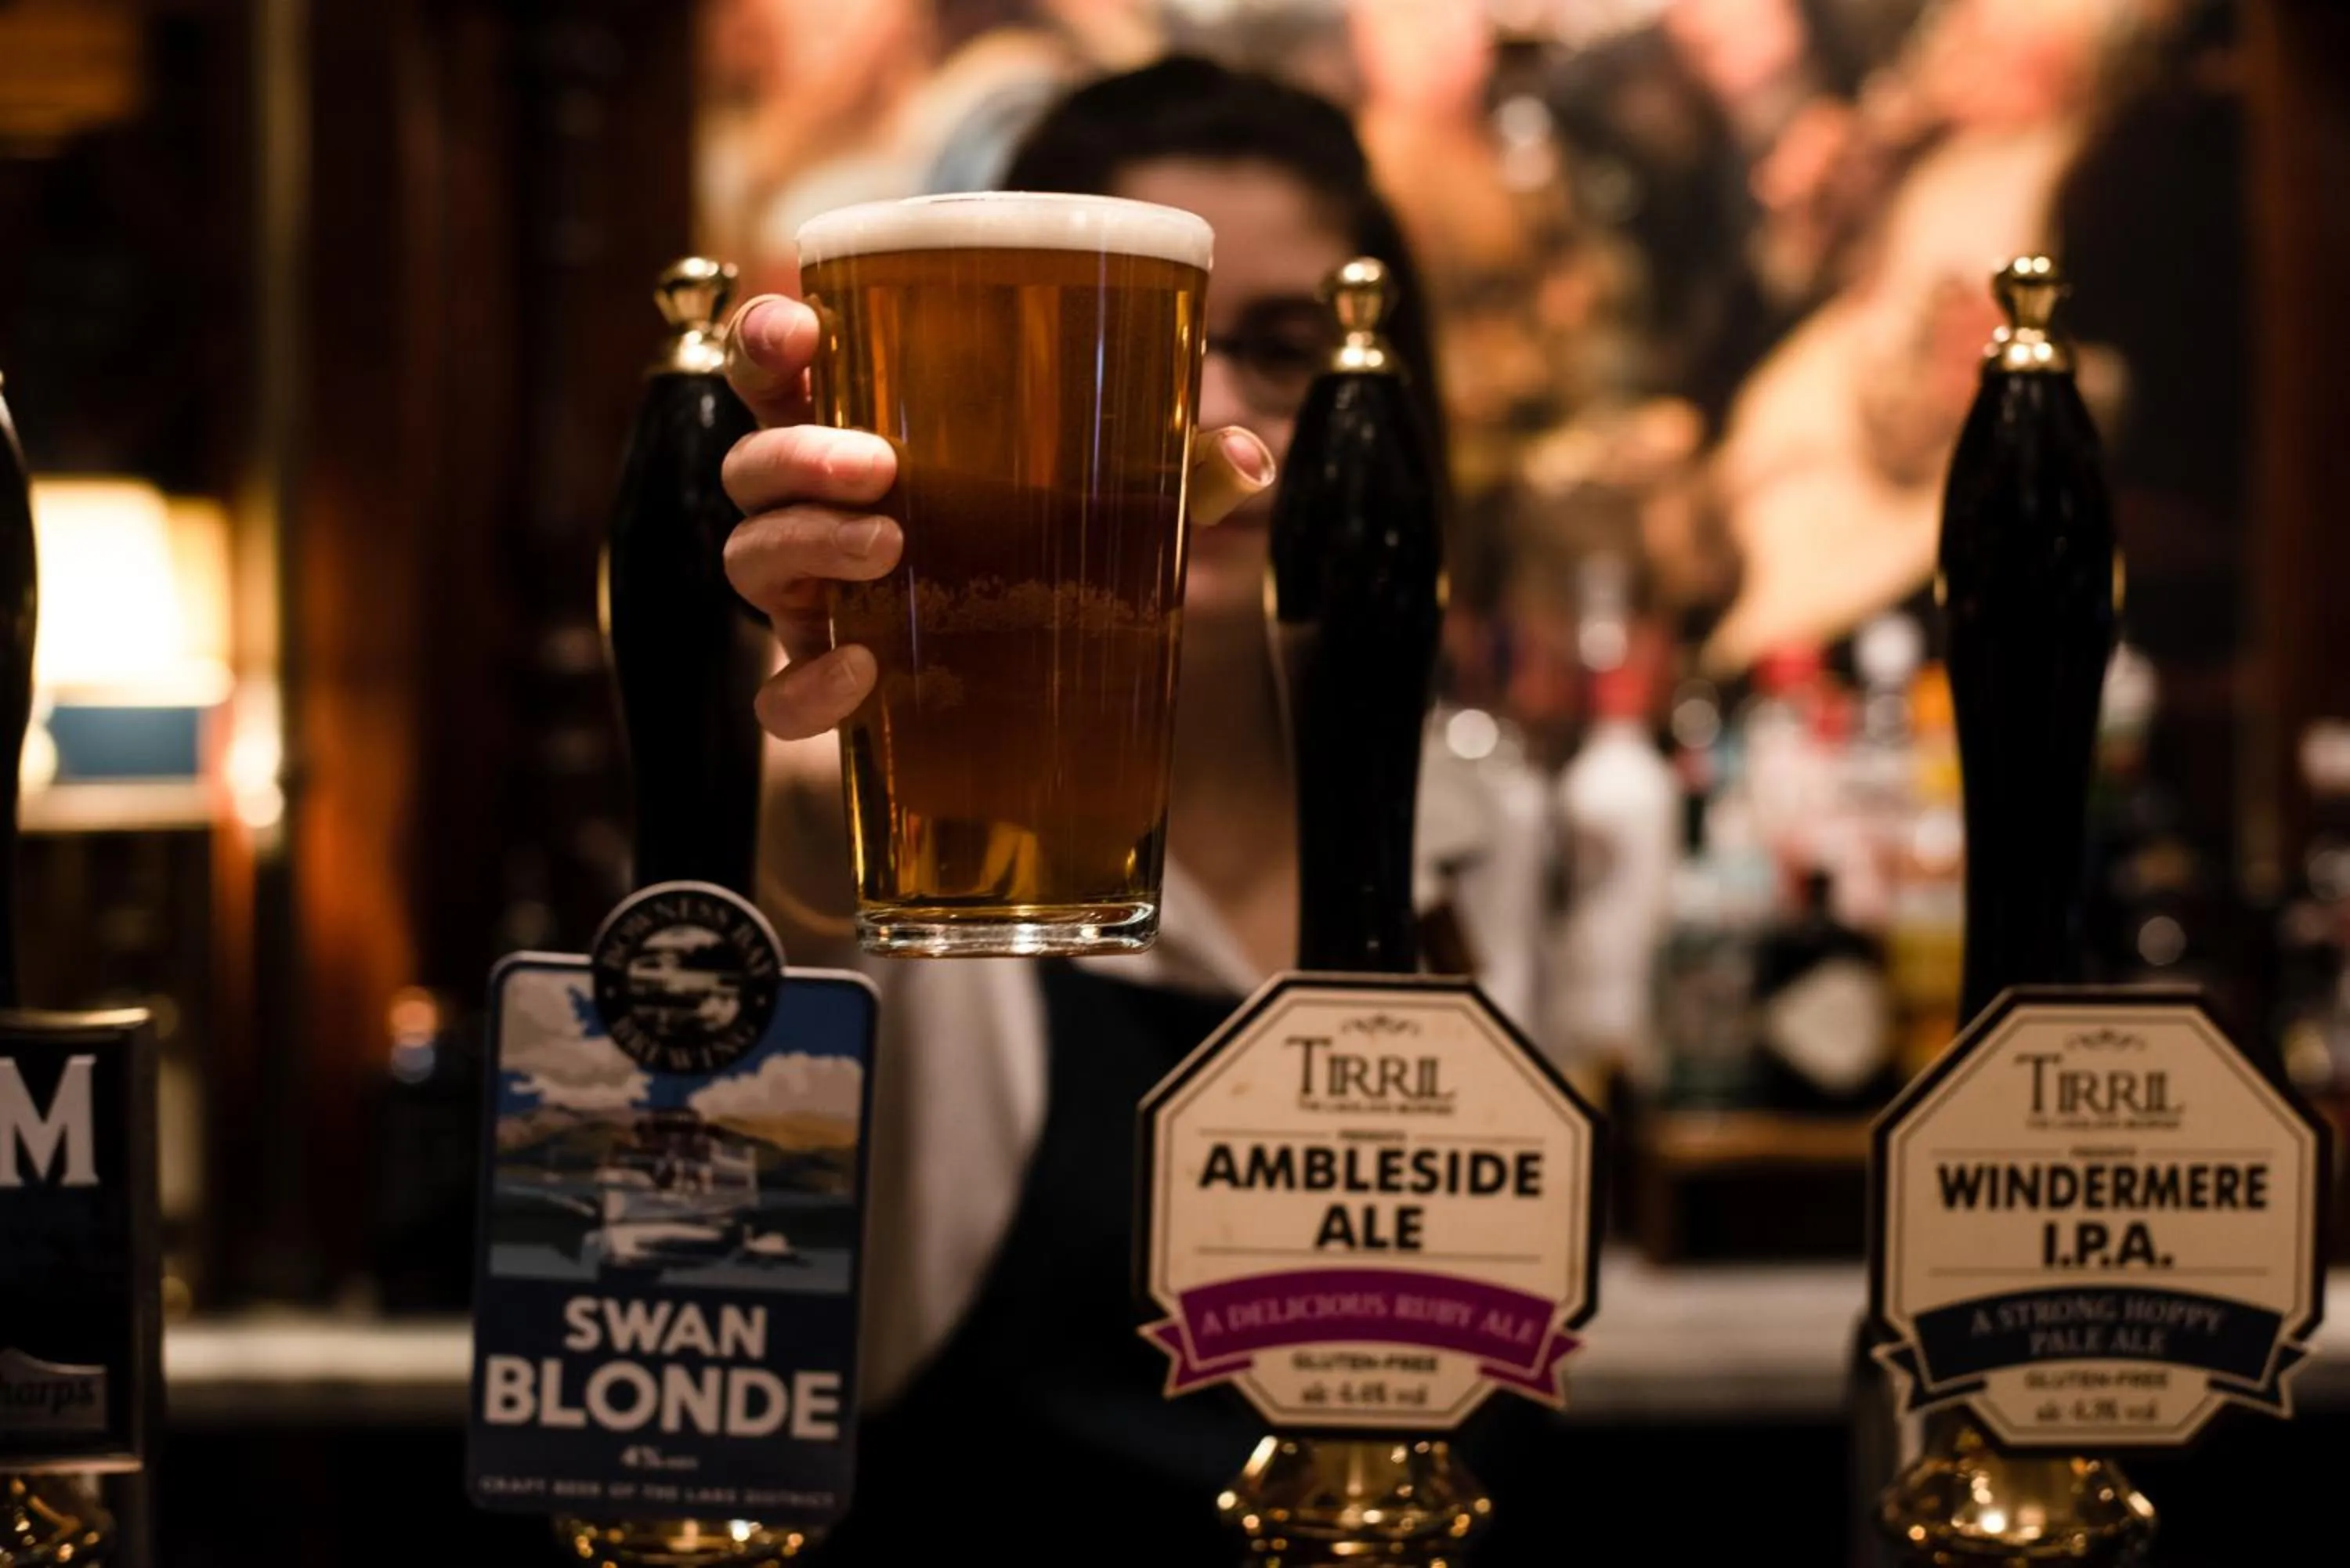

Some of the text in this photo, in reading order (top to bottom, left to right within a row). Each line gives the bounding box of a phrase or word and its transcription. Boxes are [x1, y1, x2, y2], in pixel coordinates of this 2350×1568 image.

[0, 1055, 98, 1187] M
[1196, 1143, 1544, 1199] AMBLESIDE
[1936, 1162, 2269, 1211] WINDERMERE
[1314, 1202, 1425, 1252] ALE
[2041, 1220, 2175, 1270] I.P.A.
[562, 1295, 768, 1359] SWAN
[1200, 1291, 1535, 1346] A DELICIOUS RUBY ALE
[1970, 1294, 2228, 1339] A STRONG HOPPY
[2028, 1325, 2167, 1357] PALE ALE
[483, 1354, 842, 1440] BLONDE
